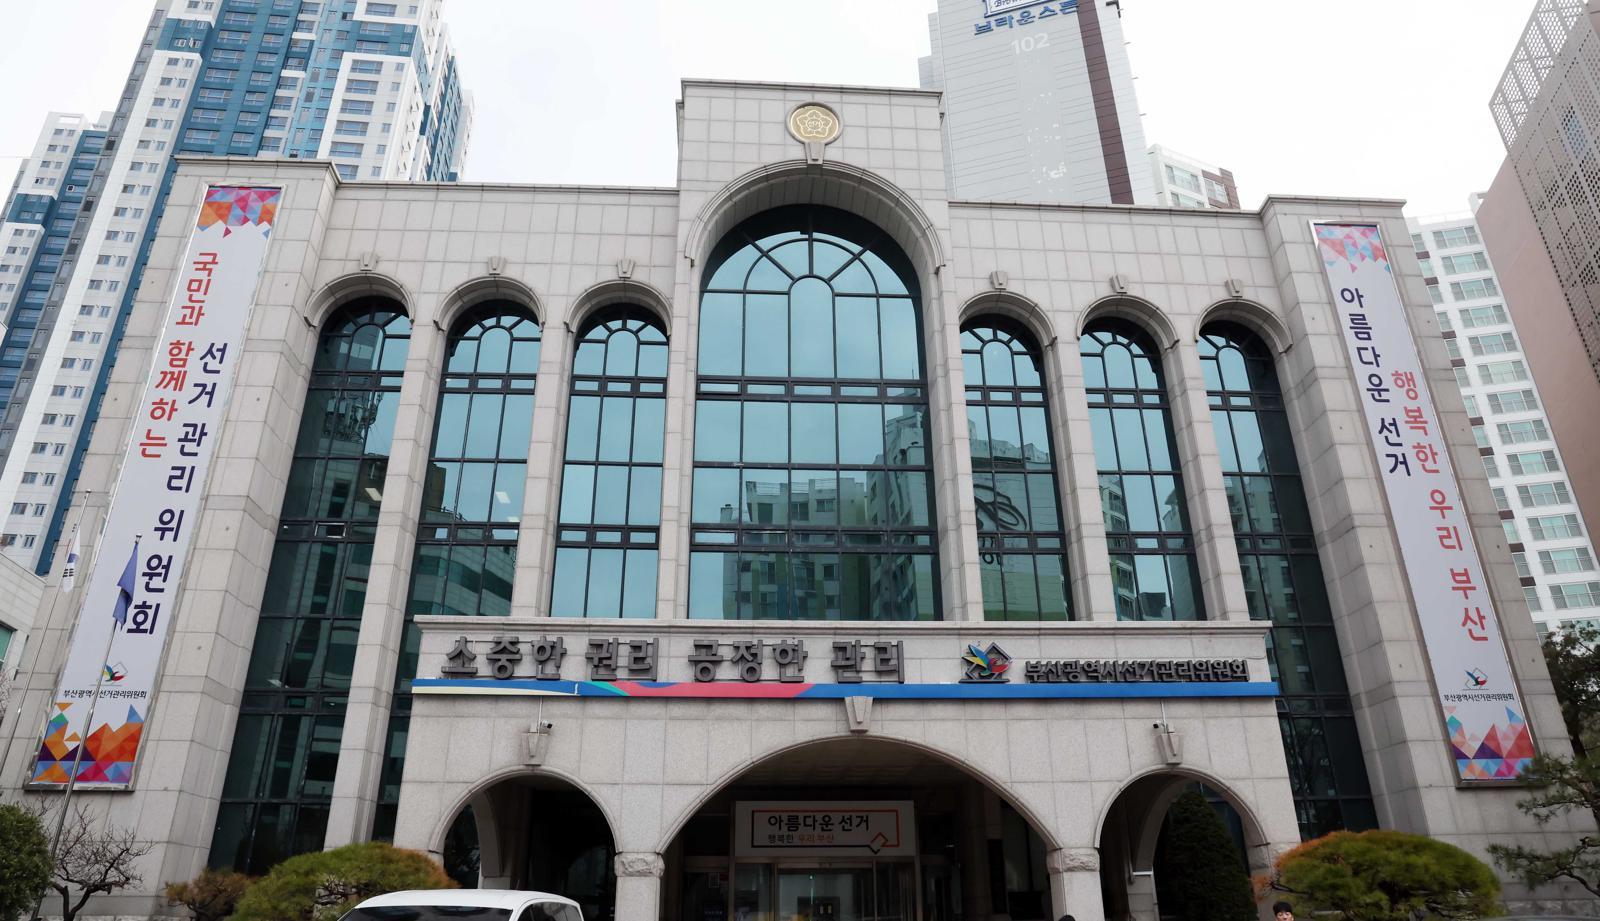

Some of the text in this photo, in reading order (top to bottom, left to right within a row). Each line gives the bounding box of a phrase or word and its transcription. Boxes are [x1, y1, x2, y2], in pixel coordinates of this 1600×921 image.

[1011, 32, 1050, 55] 102
[140, 252, 219, 459] 국민과 함께하는
[1340, 286, 1412, 477] 아름다운 선거
[126, 342, 228, 635] 선거관리위원회
[1392, 369, 1489, 642] 행복한 우리 부산
[441, 636, 904, 684] 소중한 권리 공정한 관리
[1025, 659, 1250, 682] 부산광역시선거관리위원회
[1443, 693, 1515, 703] 부산광역시선거관리위원회
[767, 814, 870, 832] 아름다운 선거
